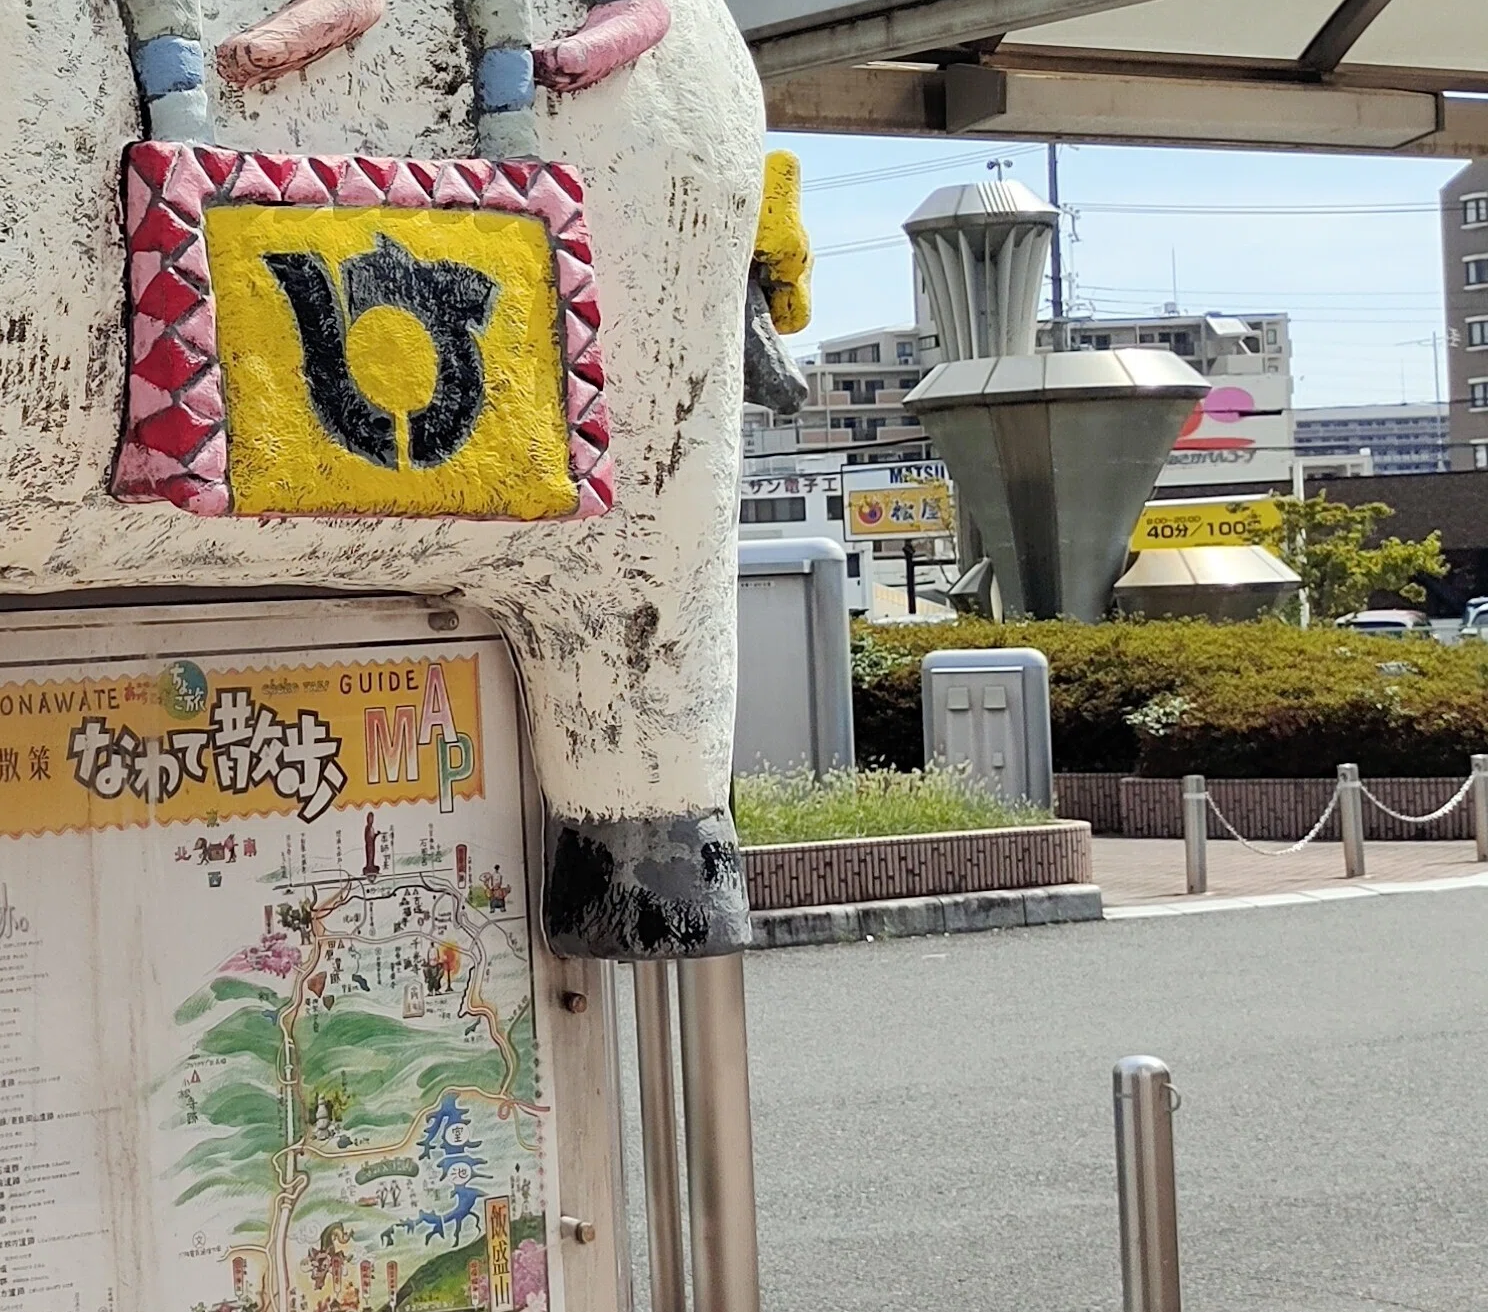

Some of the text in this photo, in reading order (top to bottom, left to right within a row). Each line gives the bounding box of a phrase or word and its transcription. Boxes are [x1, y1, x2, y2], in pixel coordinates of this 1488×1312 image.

[891, 496, 943, 523] 松屋
[340, 669, 419, 696] GUIDE
[67, 688, 348, 823] なわて散歩
[365, 663, 485, 813] MAP
[490, 1204, 511, 1308] 飯盛山
